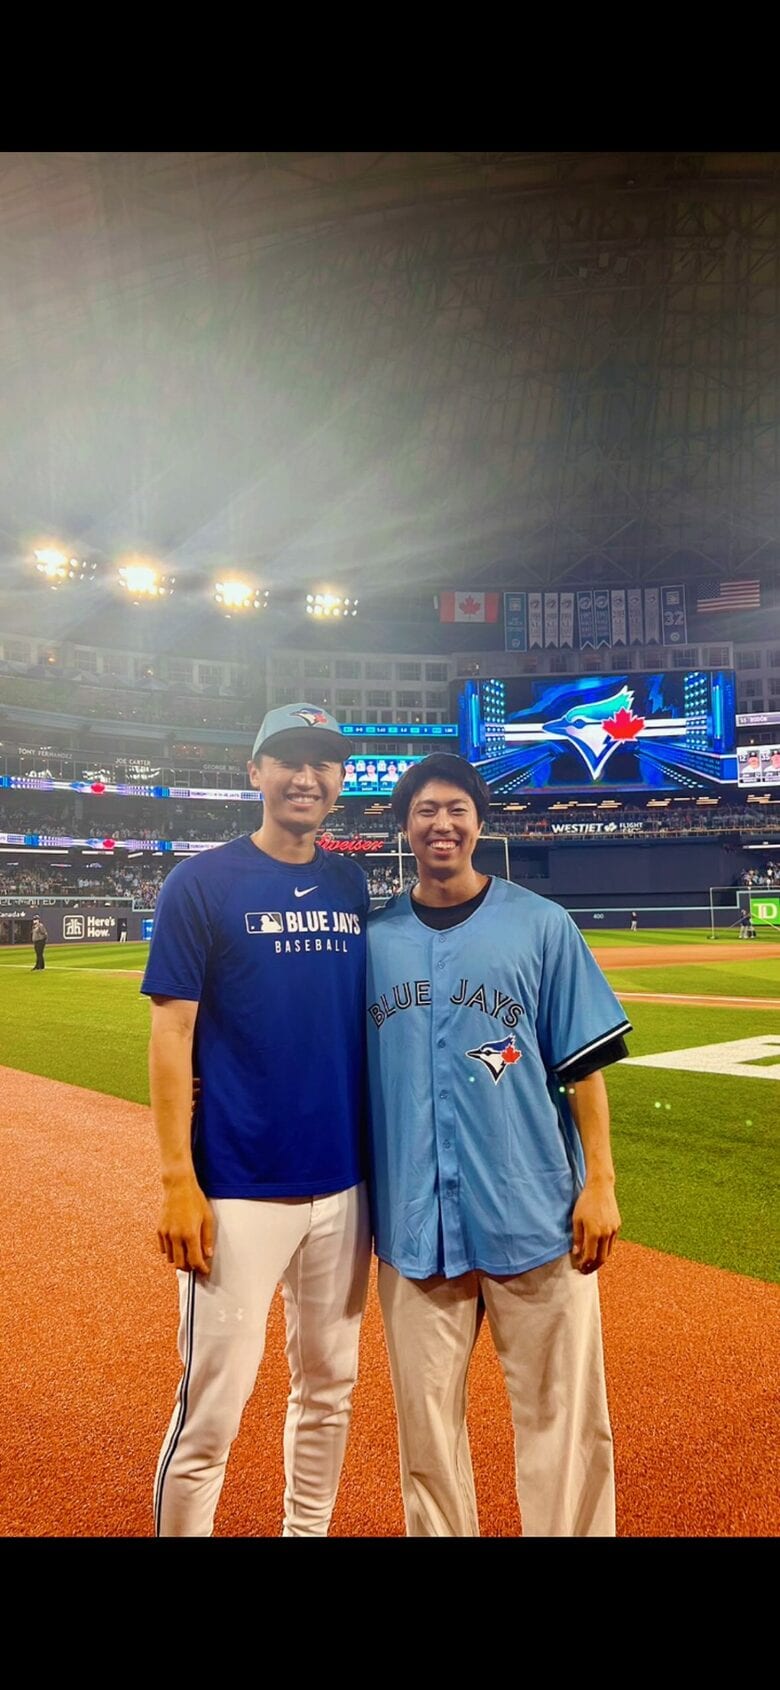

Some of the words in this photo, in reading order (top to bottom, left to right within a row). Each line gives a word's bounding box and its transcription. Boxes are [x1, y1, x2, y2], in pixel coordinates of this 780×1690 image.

[664, 611, 684, 626] 32
[18, 747, 36, 755] TONY
[38, 750, 73, 760] FERNANDEZ
[551, 823, 604, 834] WESTJET
[752, 902, 778, 919] TD
[87, 916, 115, 926] Here's
[285, 911, 330, 933] BLUE
[332, 911, 361, 935] JAYS
[87, 927, 110, 938] How.
[274, 938, 348, 954] BASEBALL
[368, 980, 432, 1030] BLUE
[450, 978, 525, 1028] JAYS
